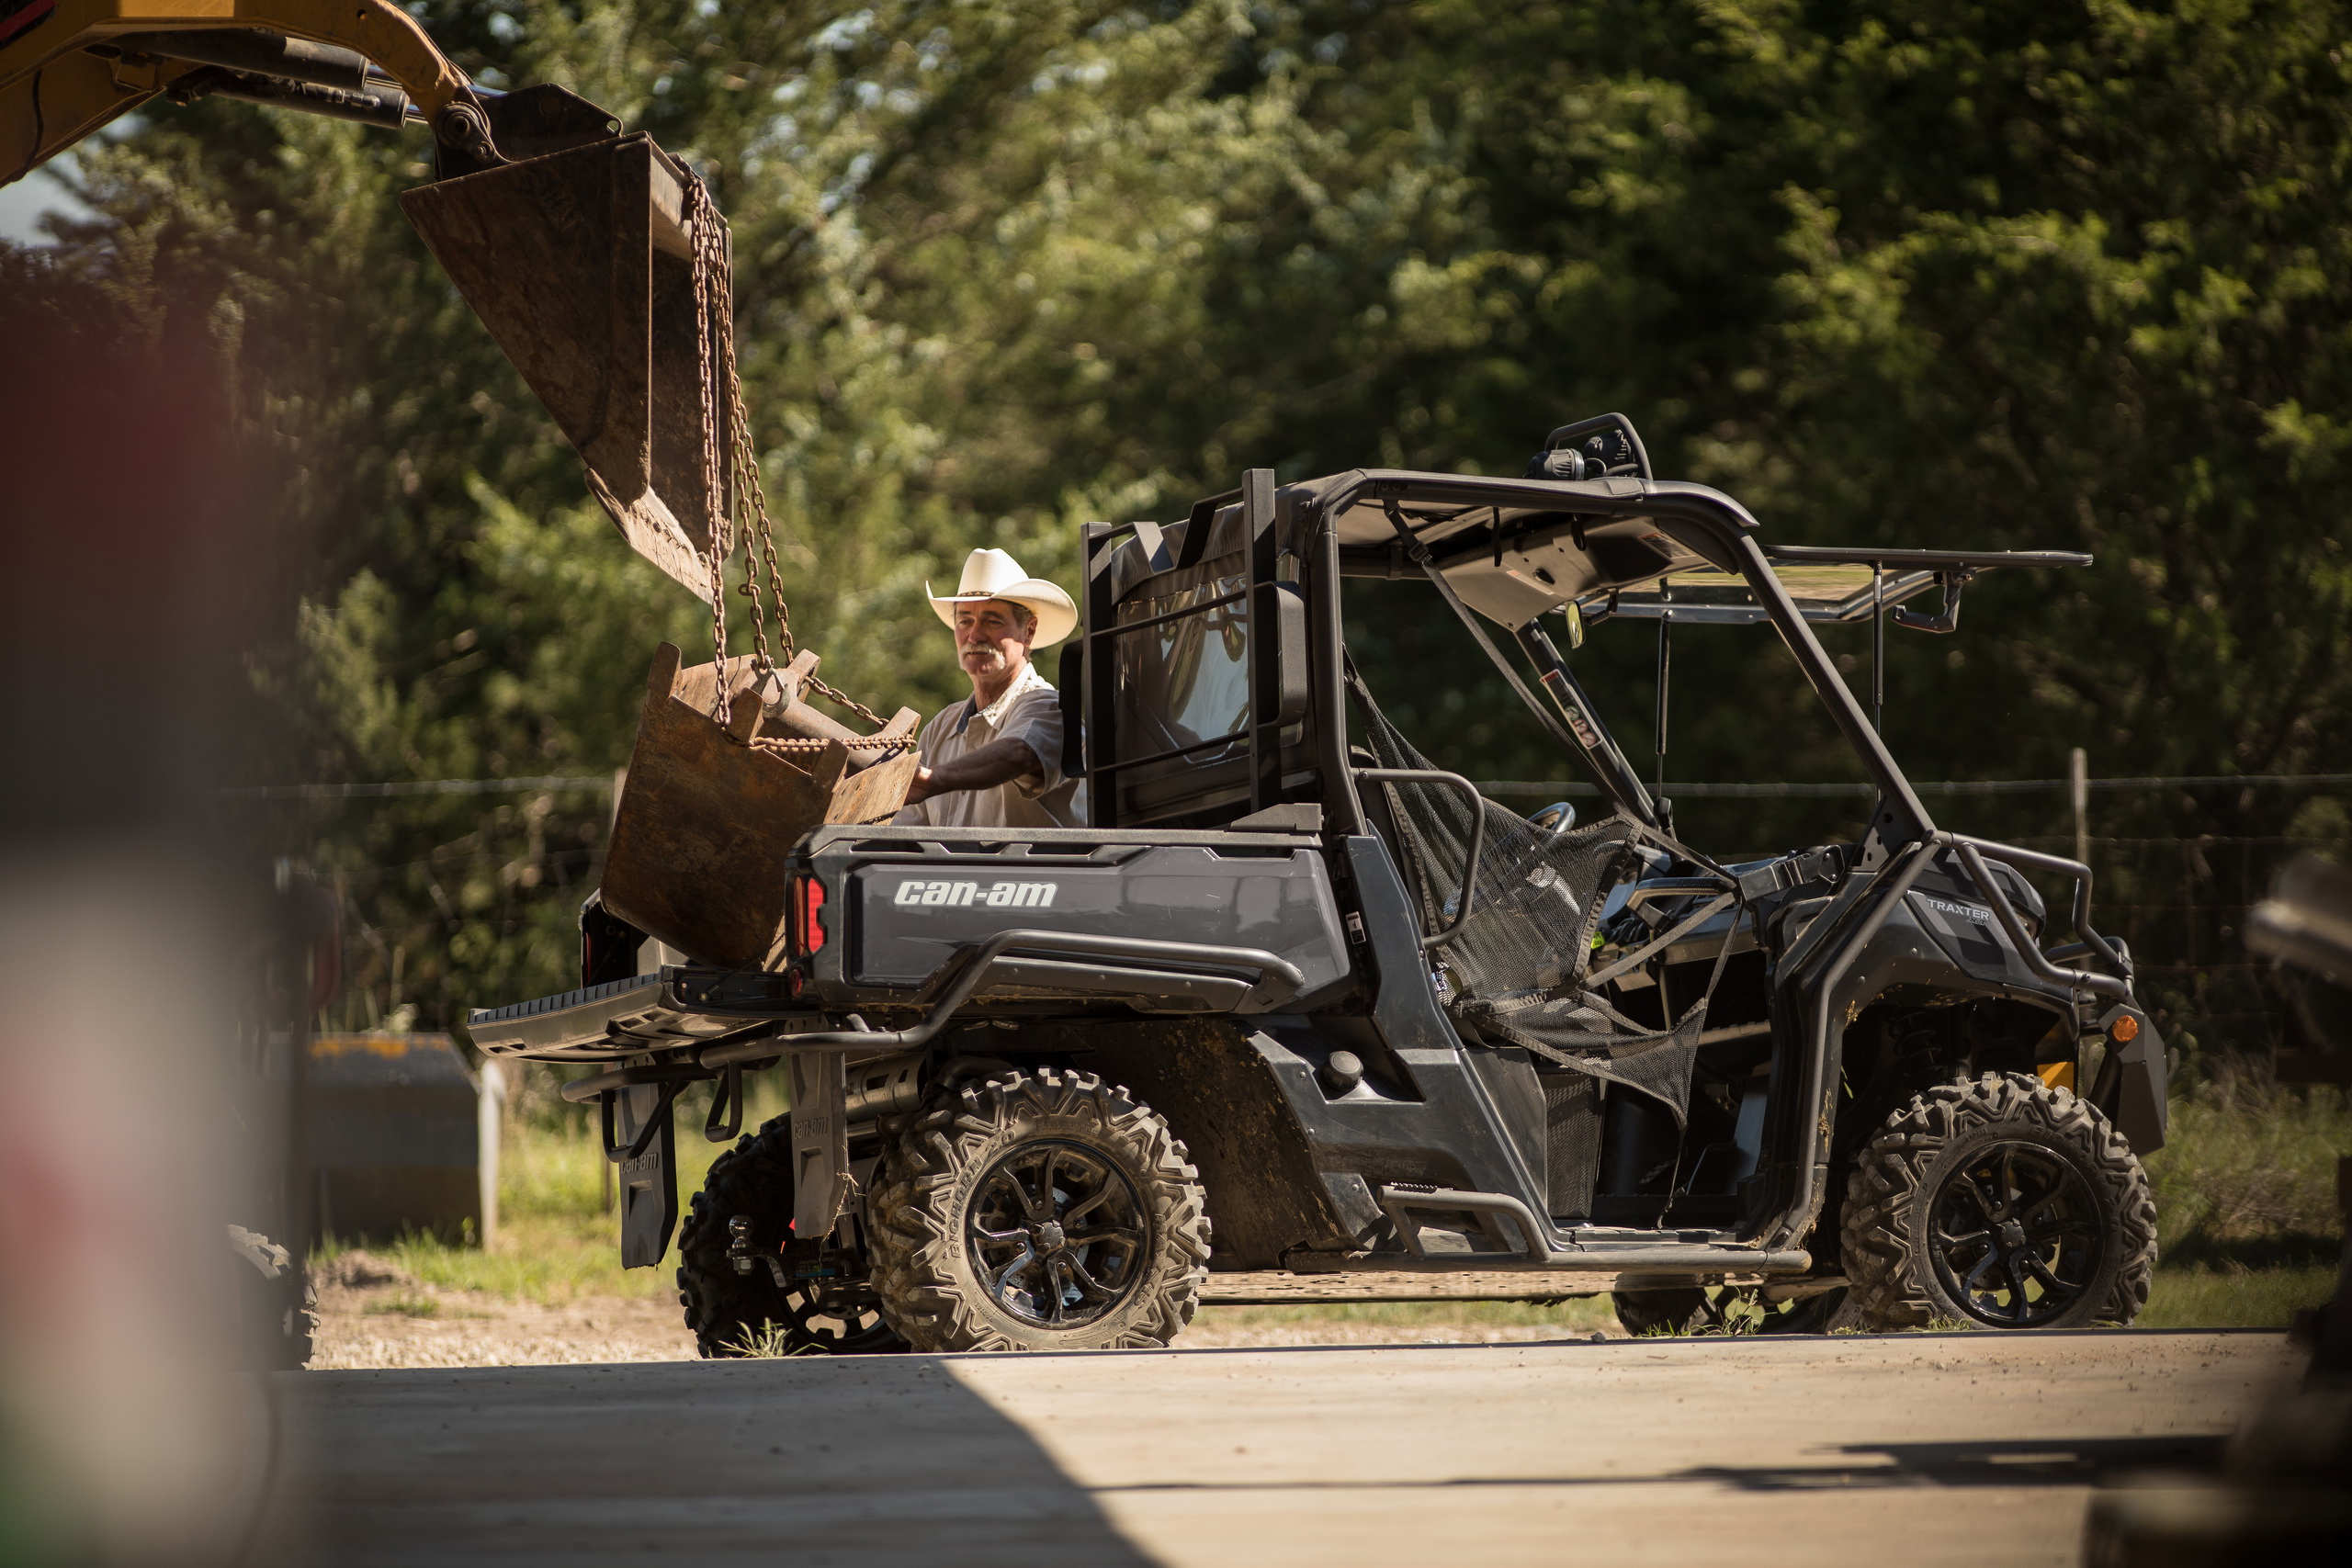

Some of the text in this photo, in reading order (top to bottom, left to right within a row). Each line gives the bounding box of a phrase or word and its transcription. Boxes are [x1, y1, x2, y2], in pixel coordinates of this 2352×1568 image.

[894, 880, 1057, 907] can-am
[1927, 898, 1990, 920] TRAXTER
[1966, 916, 1988, 926] XT
